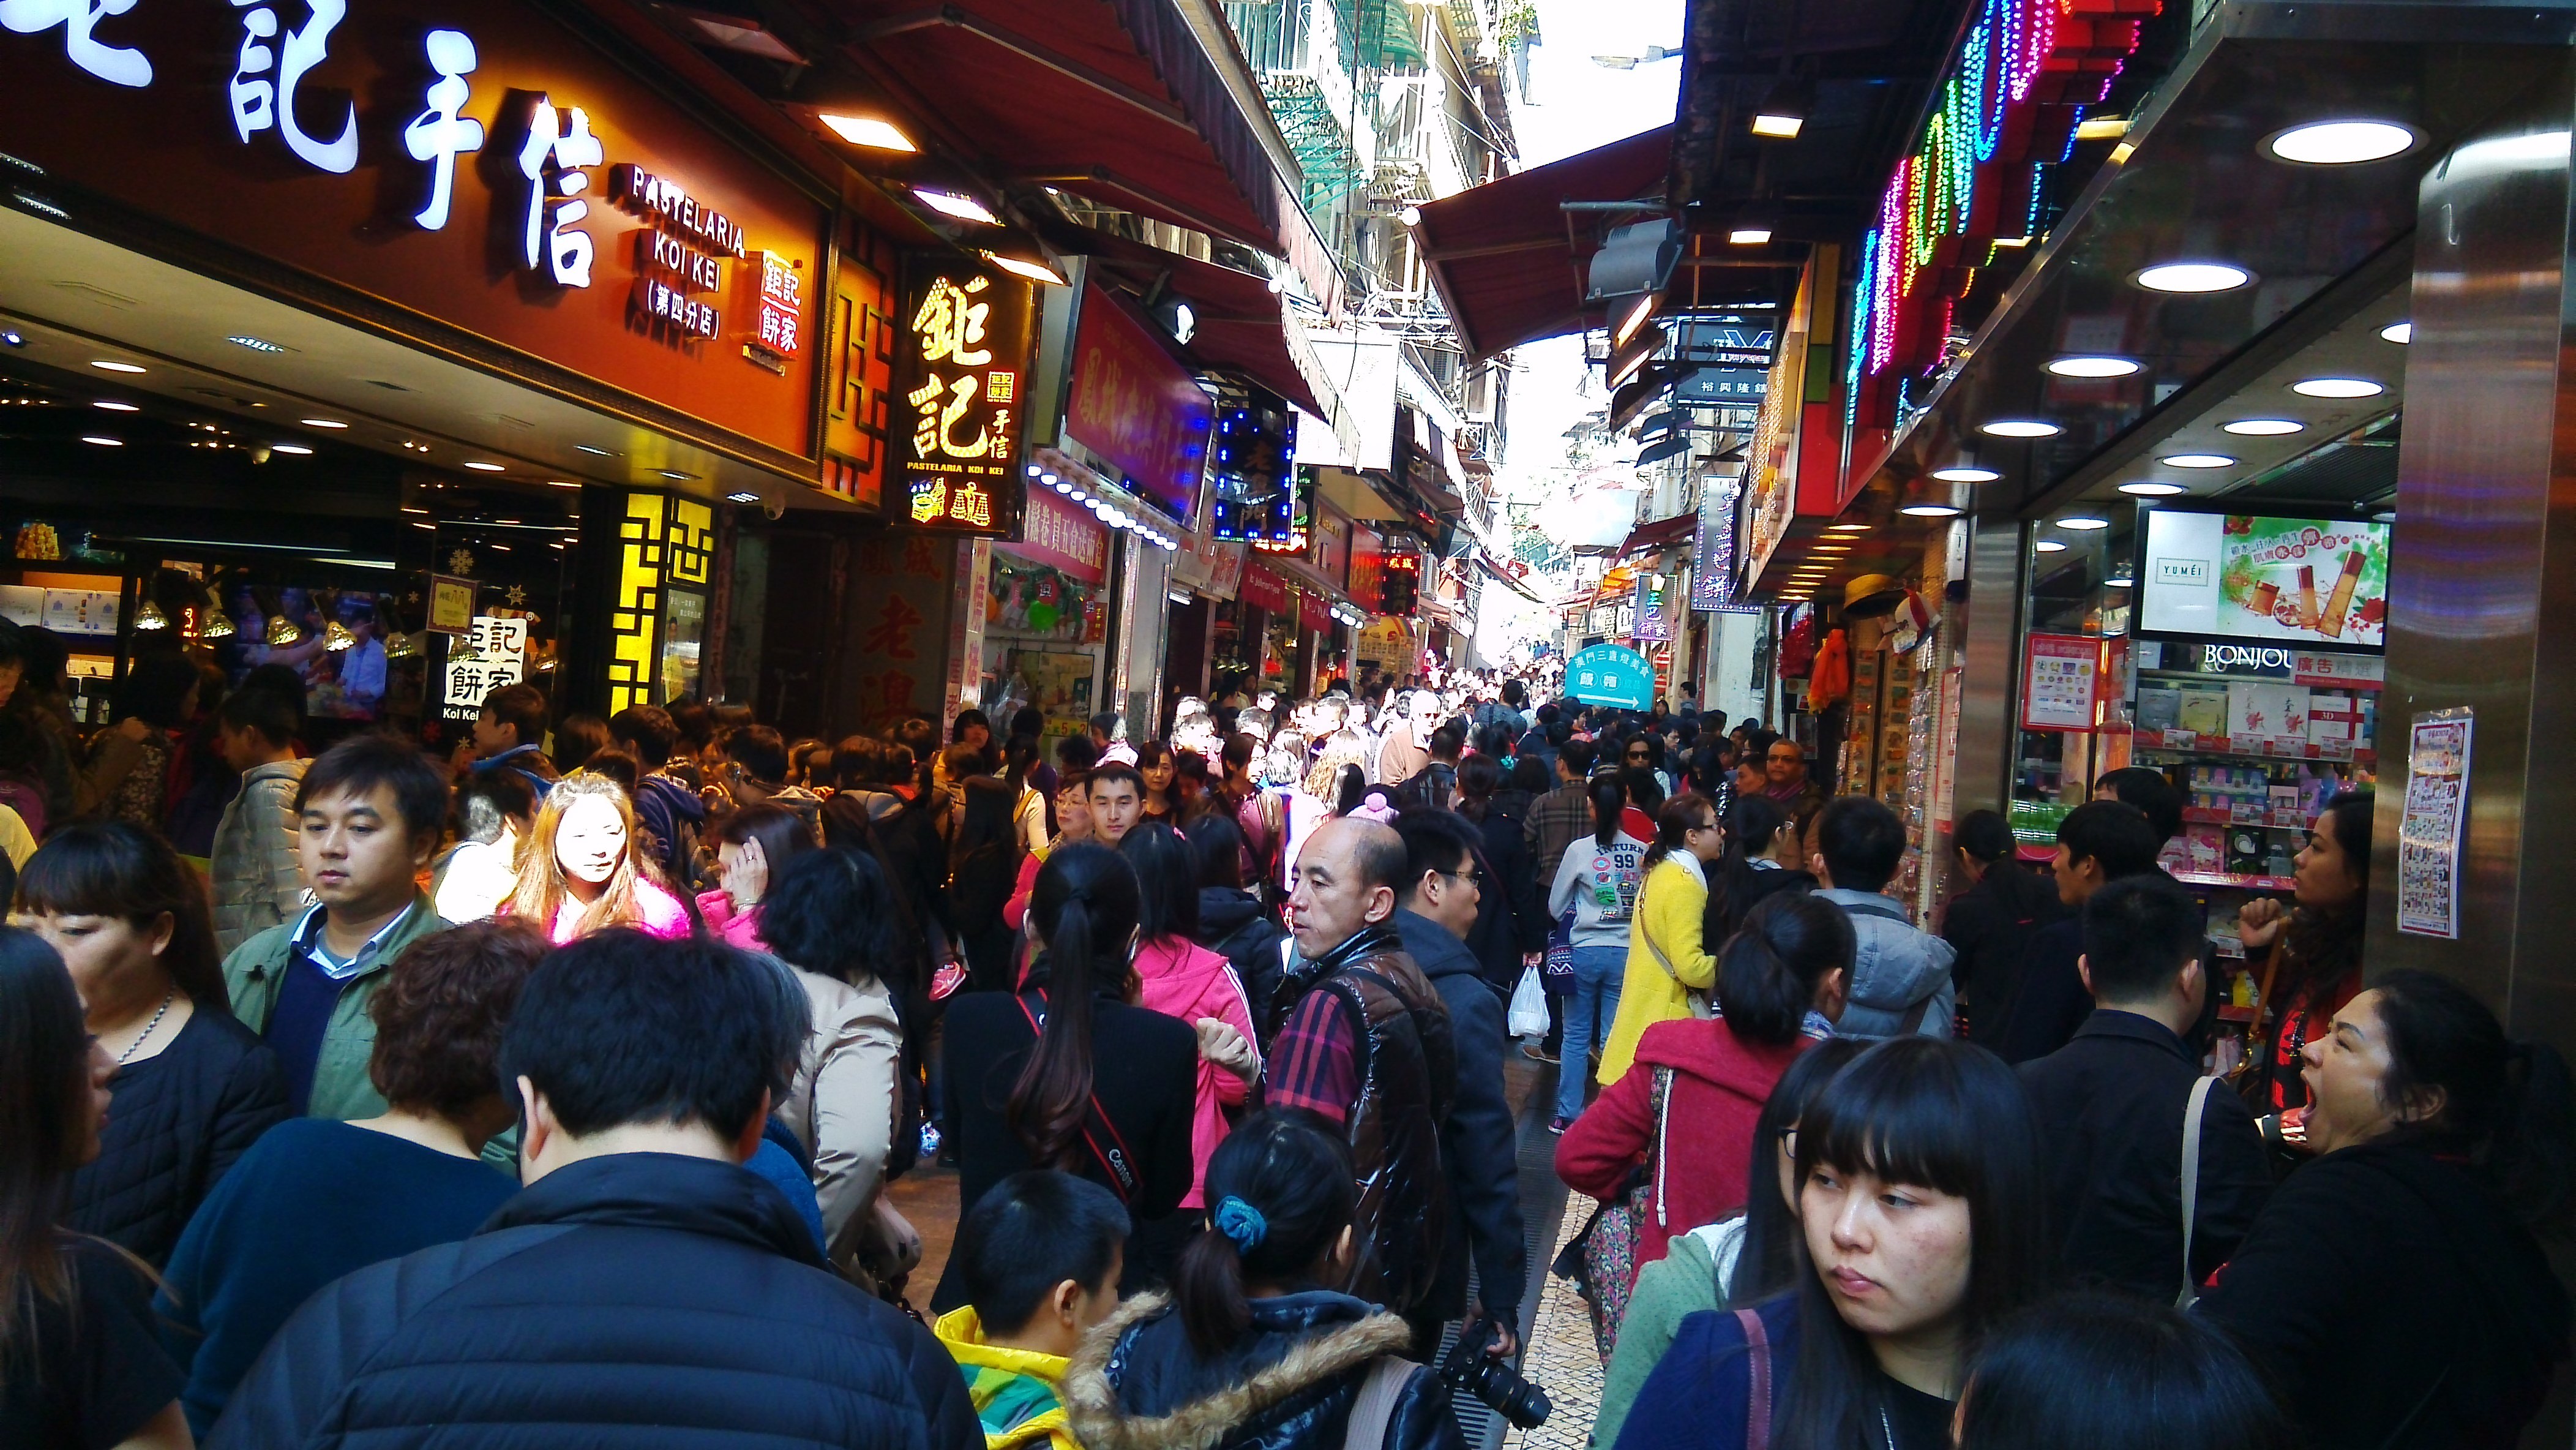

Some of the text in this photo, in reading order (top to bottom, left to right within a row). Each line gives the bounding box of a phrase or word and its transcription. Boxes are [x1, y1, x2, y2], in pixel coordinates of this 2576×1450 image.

[633, 166, 745, 259] PASTELARIA
[654, 230, 721, 293] KOI KEI
[764, 260, 801, 306] 鉅記
[648, 277, 720, 340] (第四分店)
[762, 306, 798, 352] 餅家
[907, 276, 993, 459] 鉅記
[989, 409, 1010, 459] 手信
[907, 462, 1004, 475] PASTELARIA KOI KEI
[2165, 565, 2201, 576] YUMÉI
[443, 708, 479, 721] Koi Kei
[2322, 712, 2334, 720] 3D
[1614, 854, 1635, 869] 99
[1109, 1149, 1133, 1188] Canon
